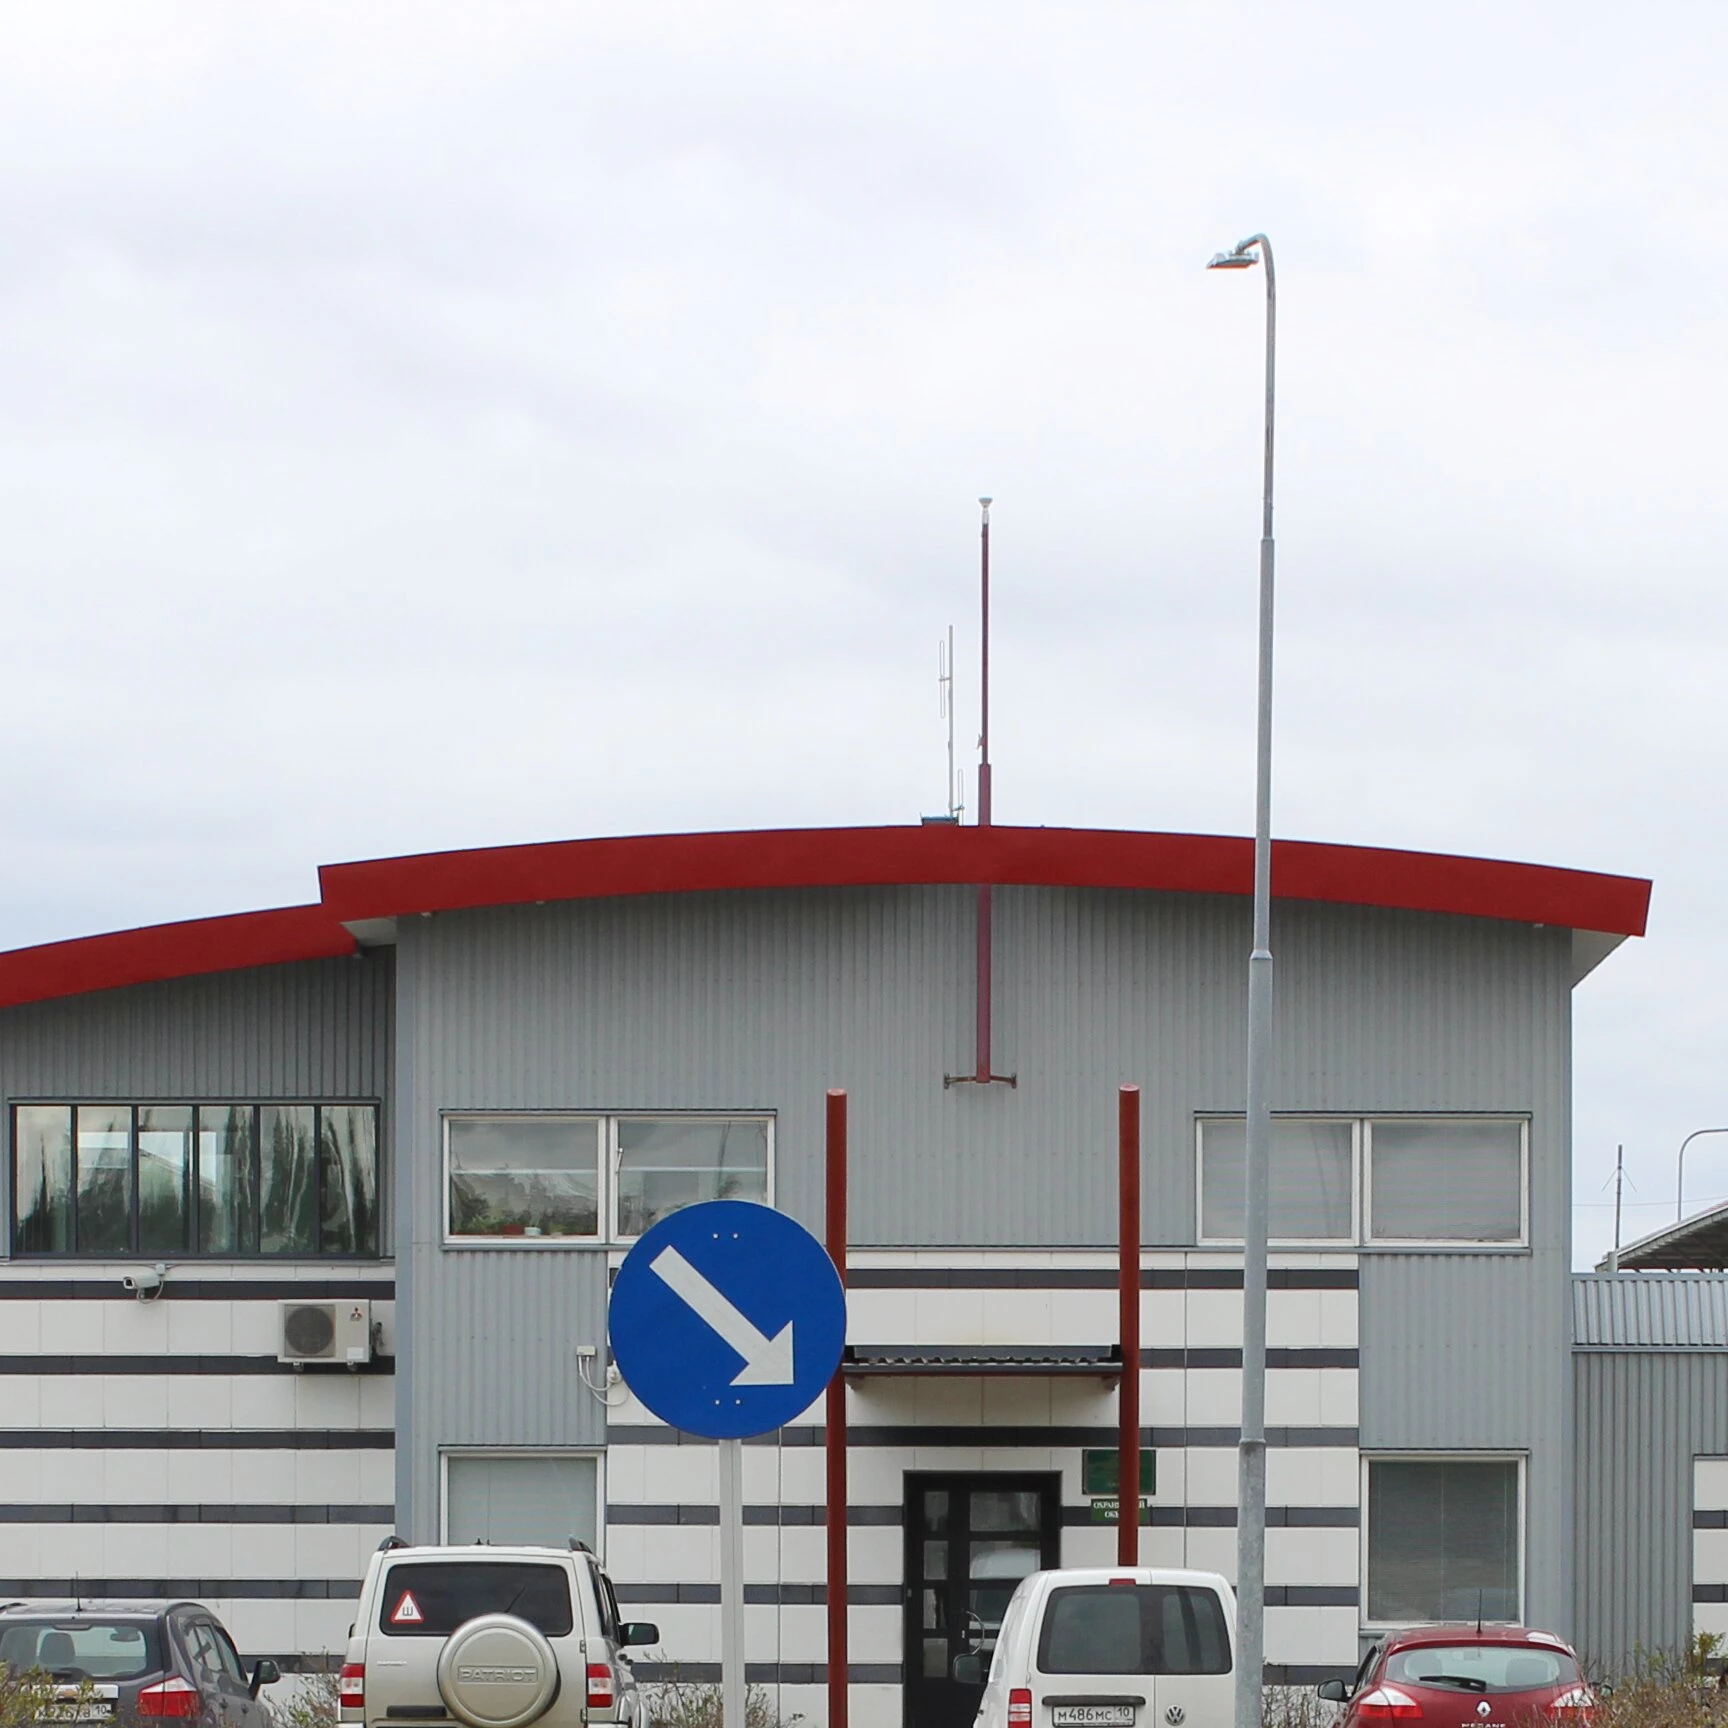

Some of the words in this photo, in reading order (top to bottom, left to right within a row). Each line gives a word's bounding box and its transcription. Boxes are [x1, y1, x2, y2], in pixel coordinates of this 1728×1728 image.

[402, 1608, 414, 1617] Ш
[460, 1668, 537, 1682] PATRIOT
[95, 1704, 107, 1715] 10
[1117, 1706, 1130, 1718] 10
